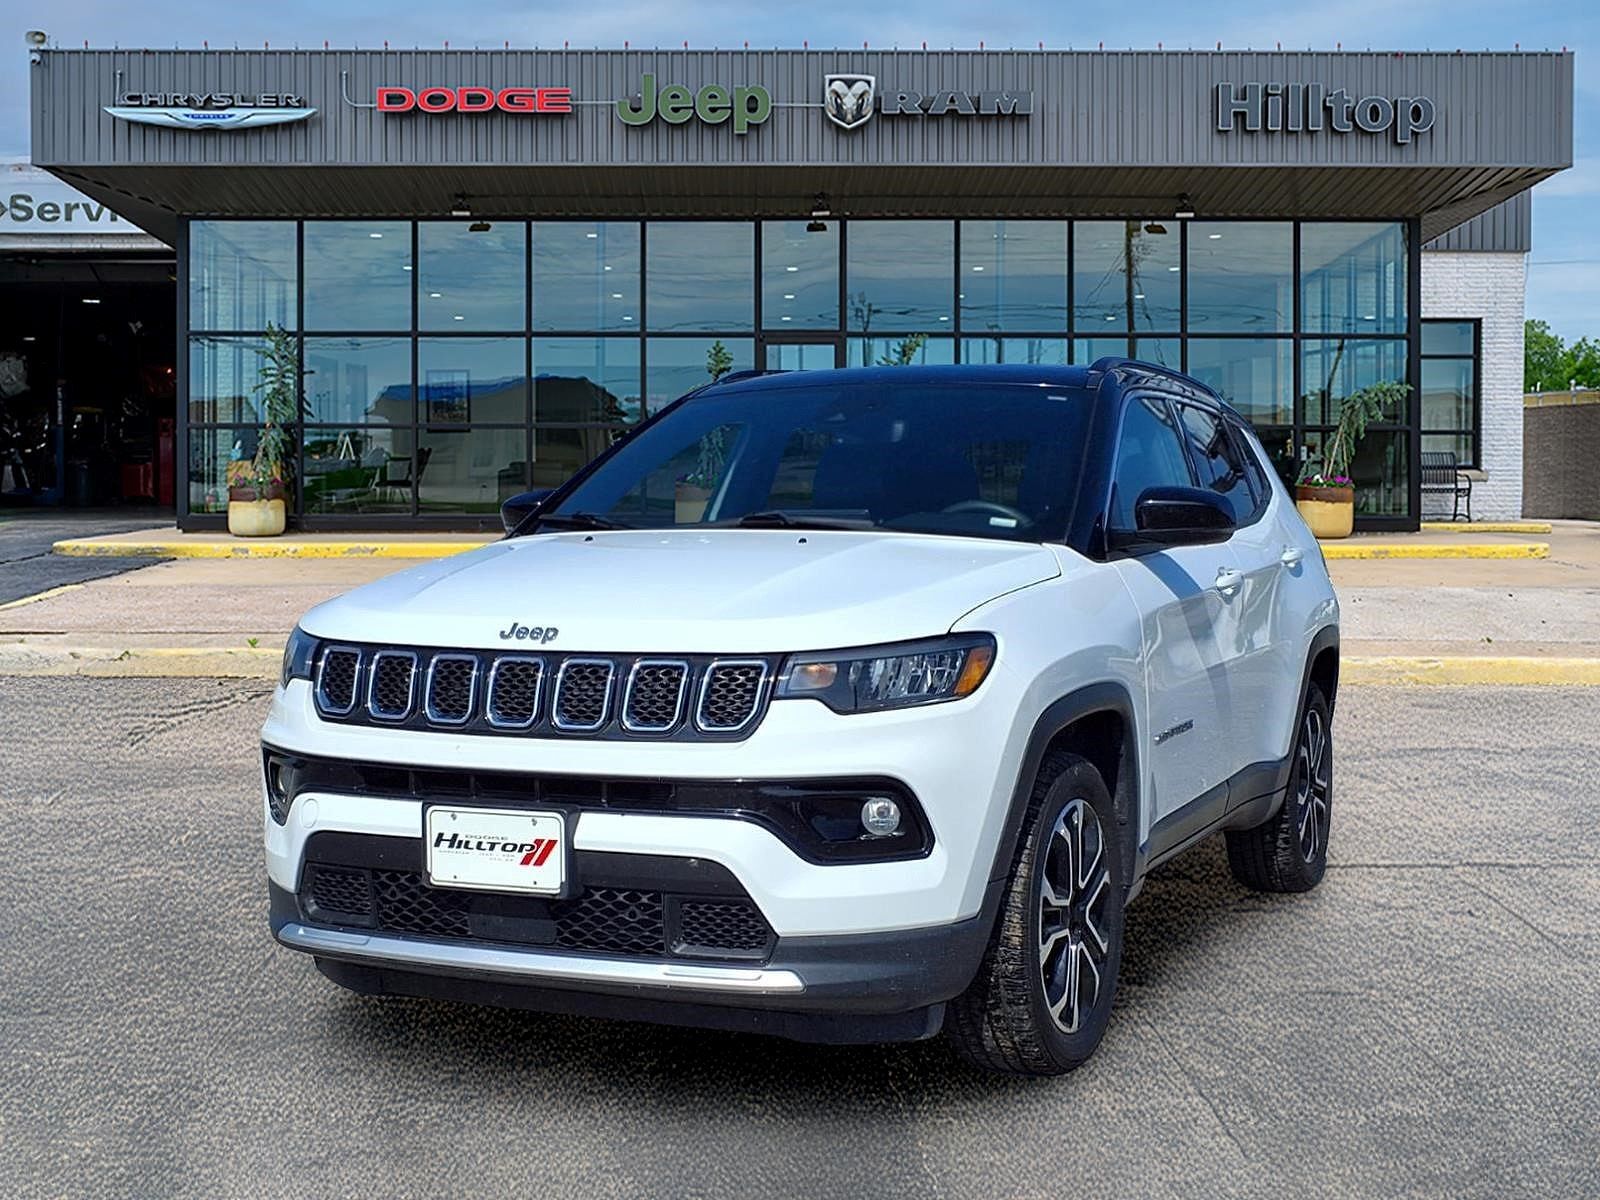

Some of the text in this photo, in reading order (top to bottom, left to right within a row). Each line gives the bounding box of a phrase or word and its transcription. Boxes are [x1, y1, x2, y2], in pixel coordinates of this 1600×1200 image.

[120, 92, 303, 107] CHRYSLER
[376, 86, 572, 114] DODGE
[616, 72, 772, 135] Jeep
[880, 89, 1034, 115] RAM
[1217, 81, 1437, 144] Hilltop
[499, 622, 559, 645] Jeep
